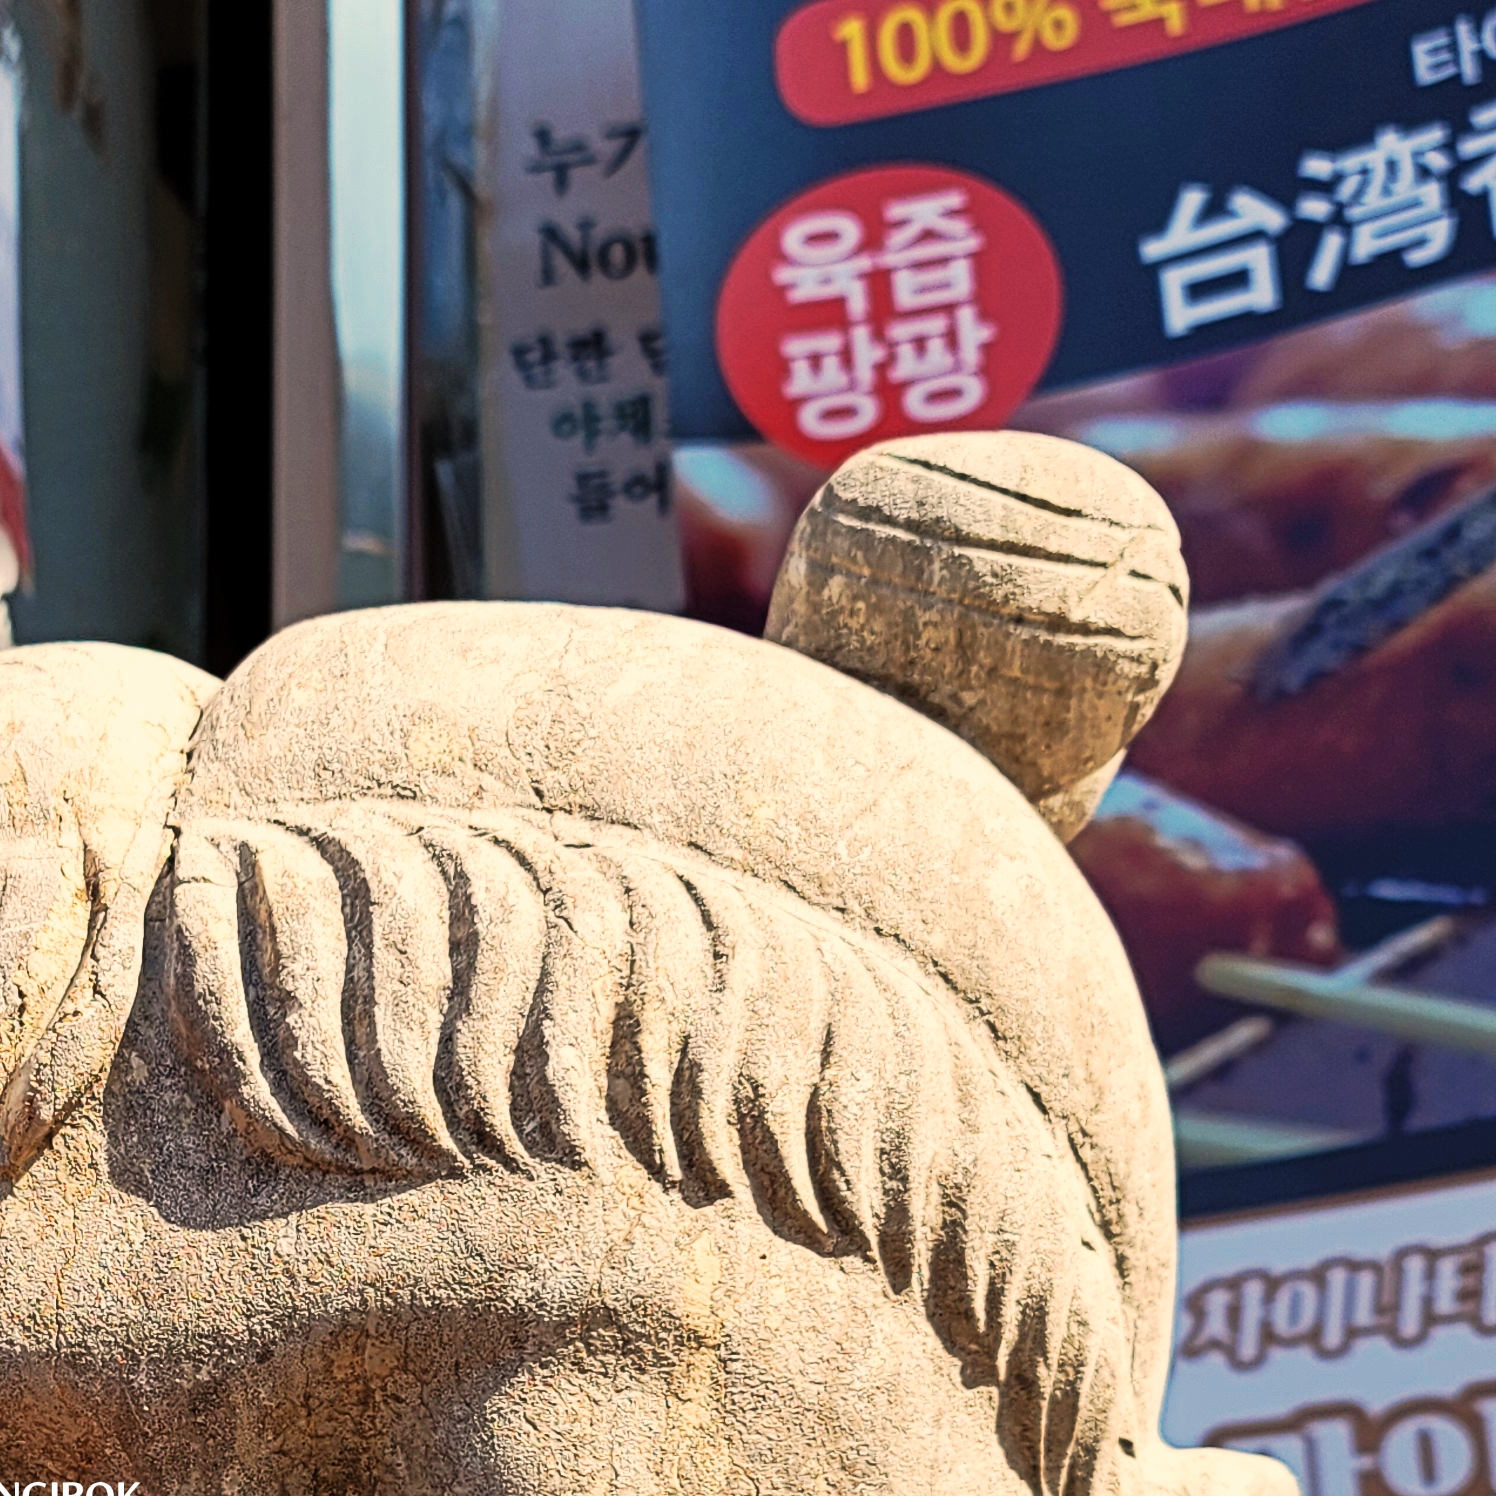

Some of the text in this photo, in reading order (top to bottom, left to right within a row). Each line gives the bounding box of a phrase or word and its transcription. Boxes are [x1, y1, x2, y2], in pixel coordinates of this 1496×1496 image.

[832, 0, 1082, 94] 100%
[772, 188, 985, 324] 육즙
[780, 303, 995, 441] 팡팡
